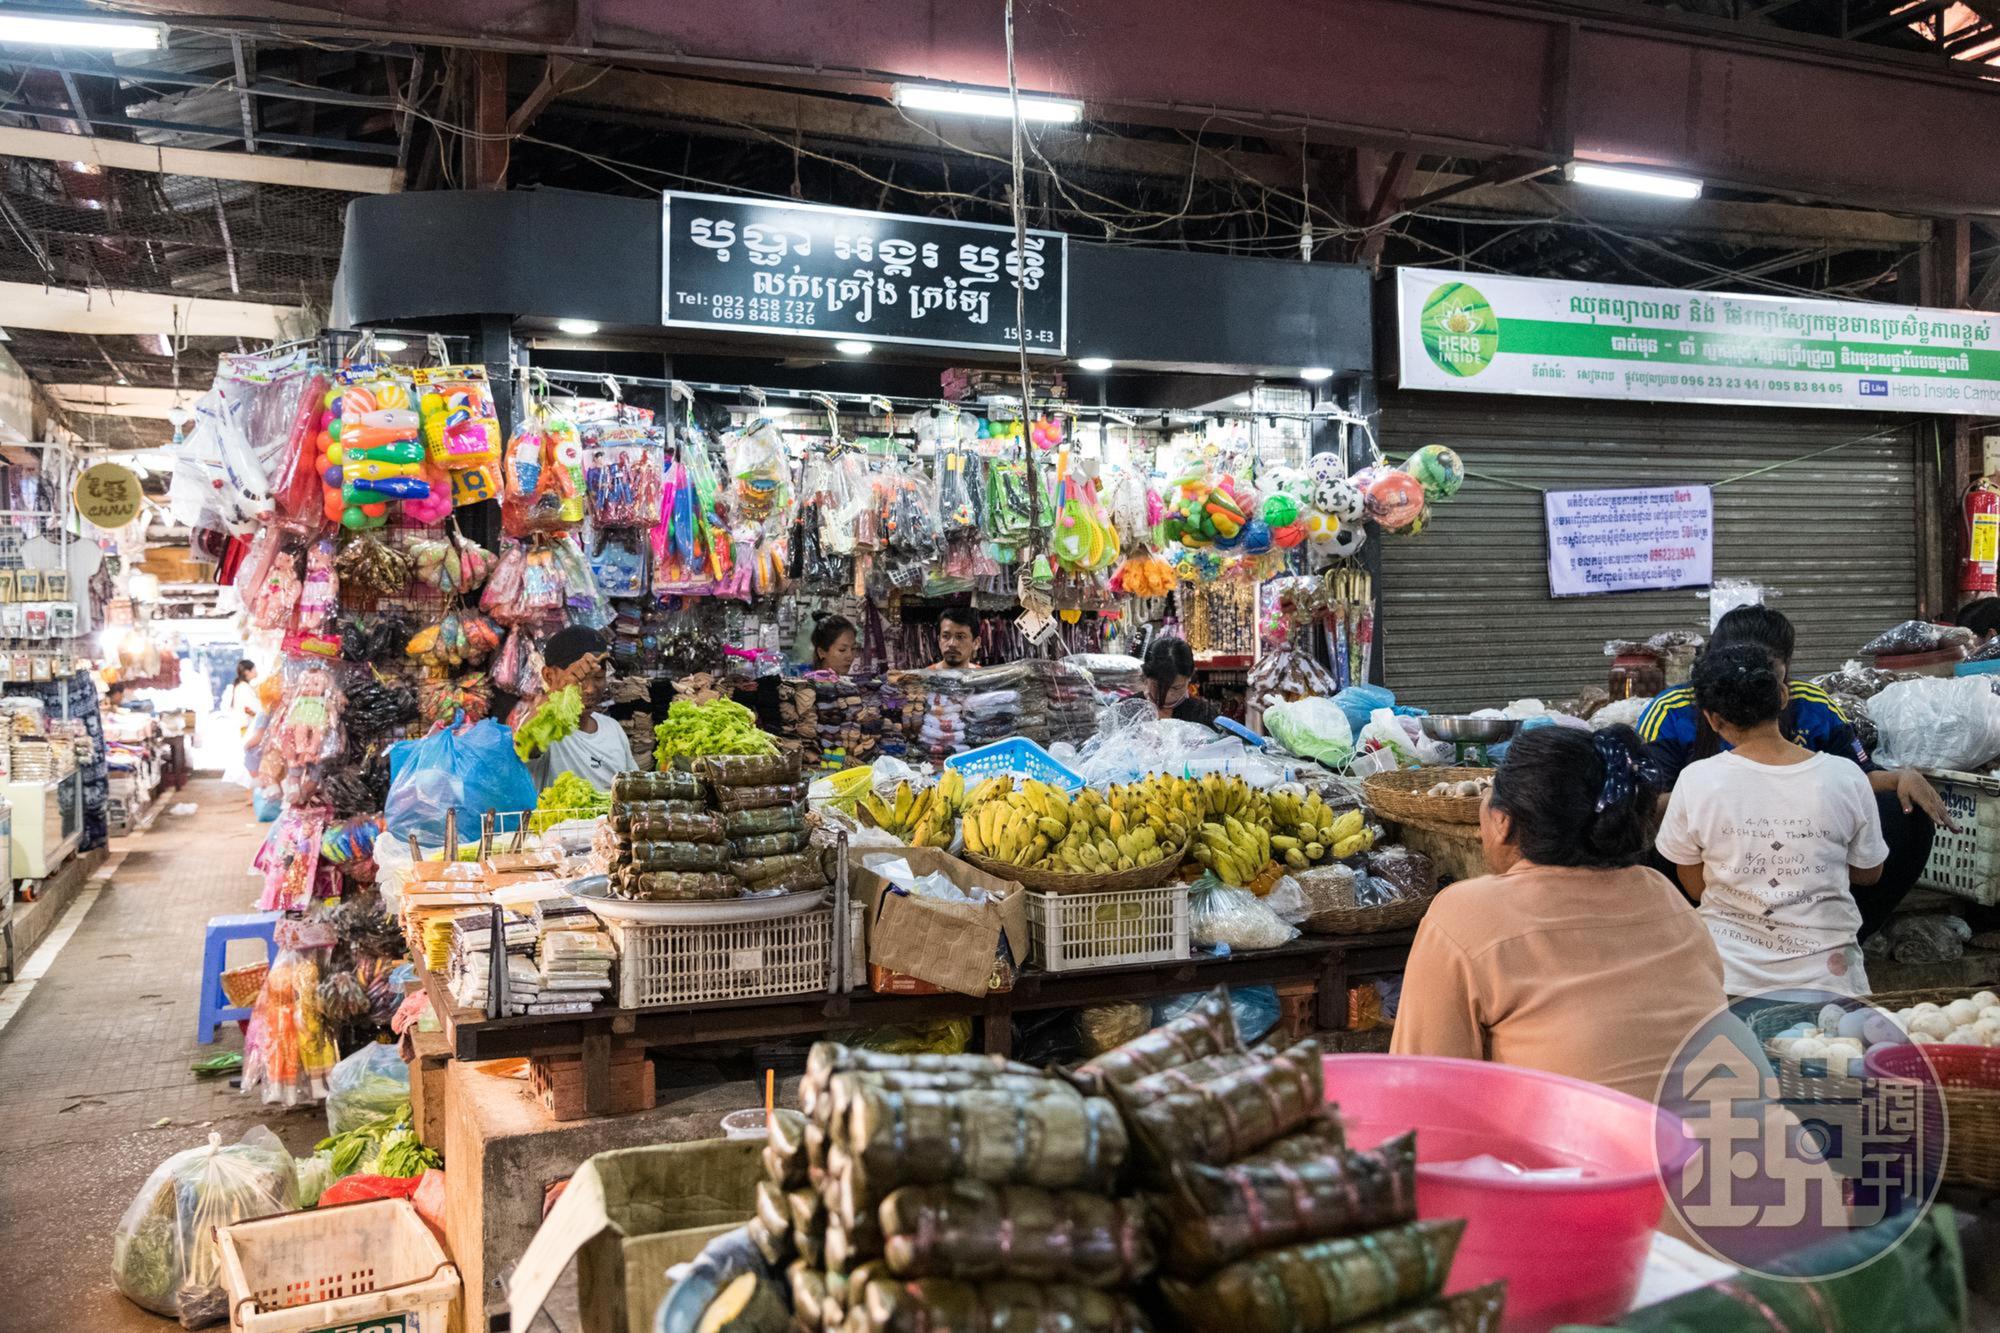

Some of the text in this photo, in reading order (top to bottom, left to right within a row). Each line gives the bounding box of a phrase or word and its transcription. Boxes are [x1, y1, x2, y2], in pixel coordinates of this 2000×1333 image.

[834, 233, 939, 277] អង្គរ
[676, 292, 815, 313] Tel: 092 458 737
[1689, 299, 1715, 324] និង
[713, 306, 816, 325] 069 848 326
[1003, 327, 1033, 341] 153
[1439, 335, 1480, 353] HERB
[1440, 352, 1481, 364] INSIDE
[1681, 375, 1704, 386] 096
[1708, 376, 1722, 387] 23
[1726, 378, 1740, 388] 23
[1744, 379, 1759, 389] 44
[1768, 380, 1790, 391] 095
[1794, 382, 1808, 392] 83
[1811, 382, 1826, 393] 84
[1829, 383, 1843, 393] 05
[1892, 382, 1920, 397] Herb
[1924, 383, 1960, 399] Inside
[1771, 853, 1805, 865] (SUN)
[1777, 866, 1810, 876] DRUM
